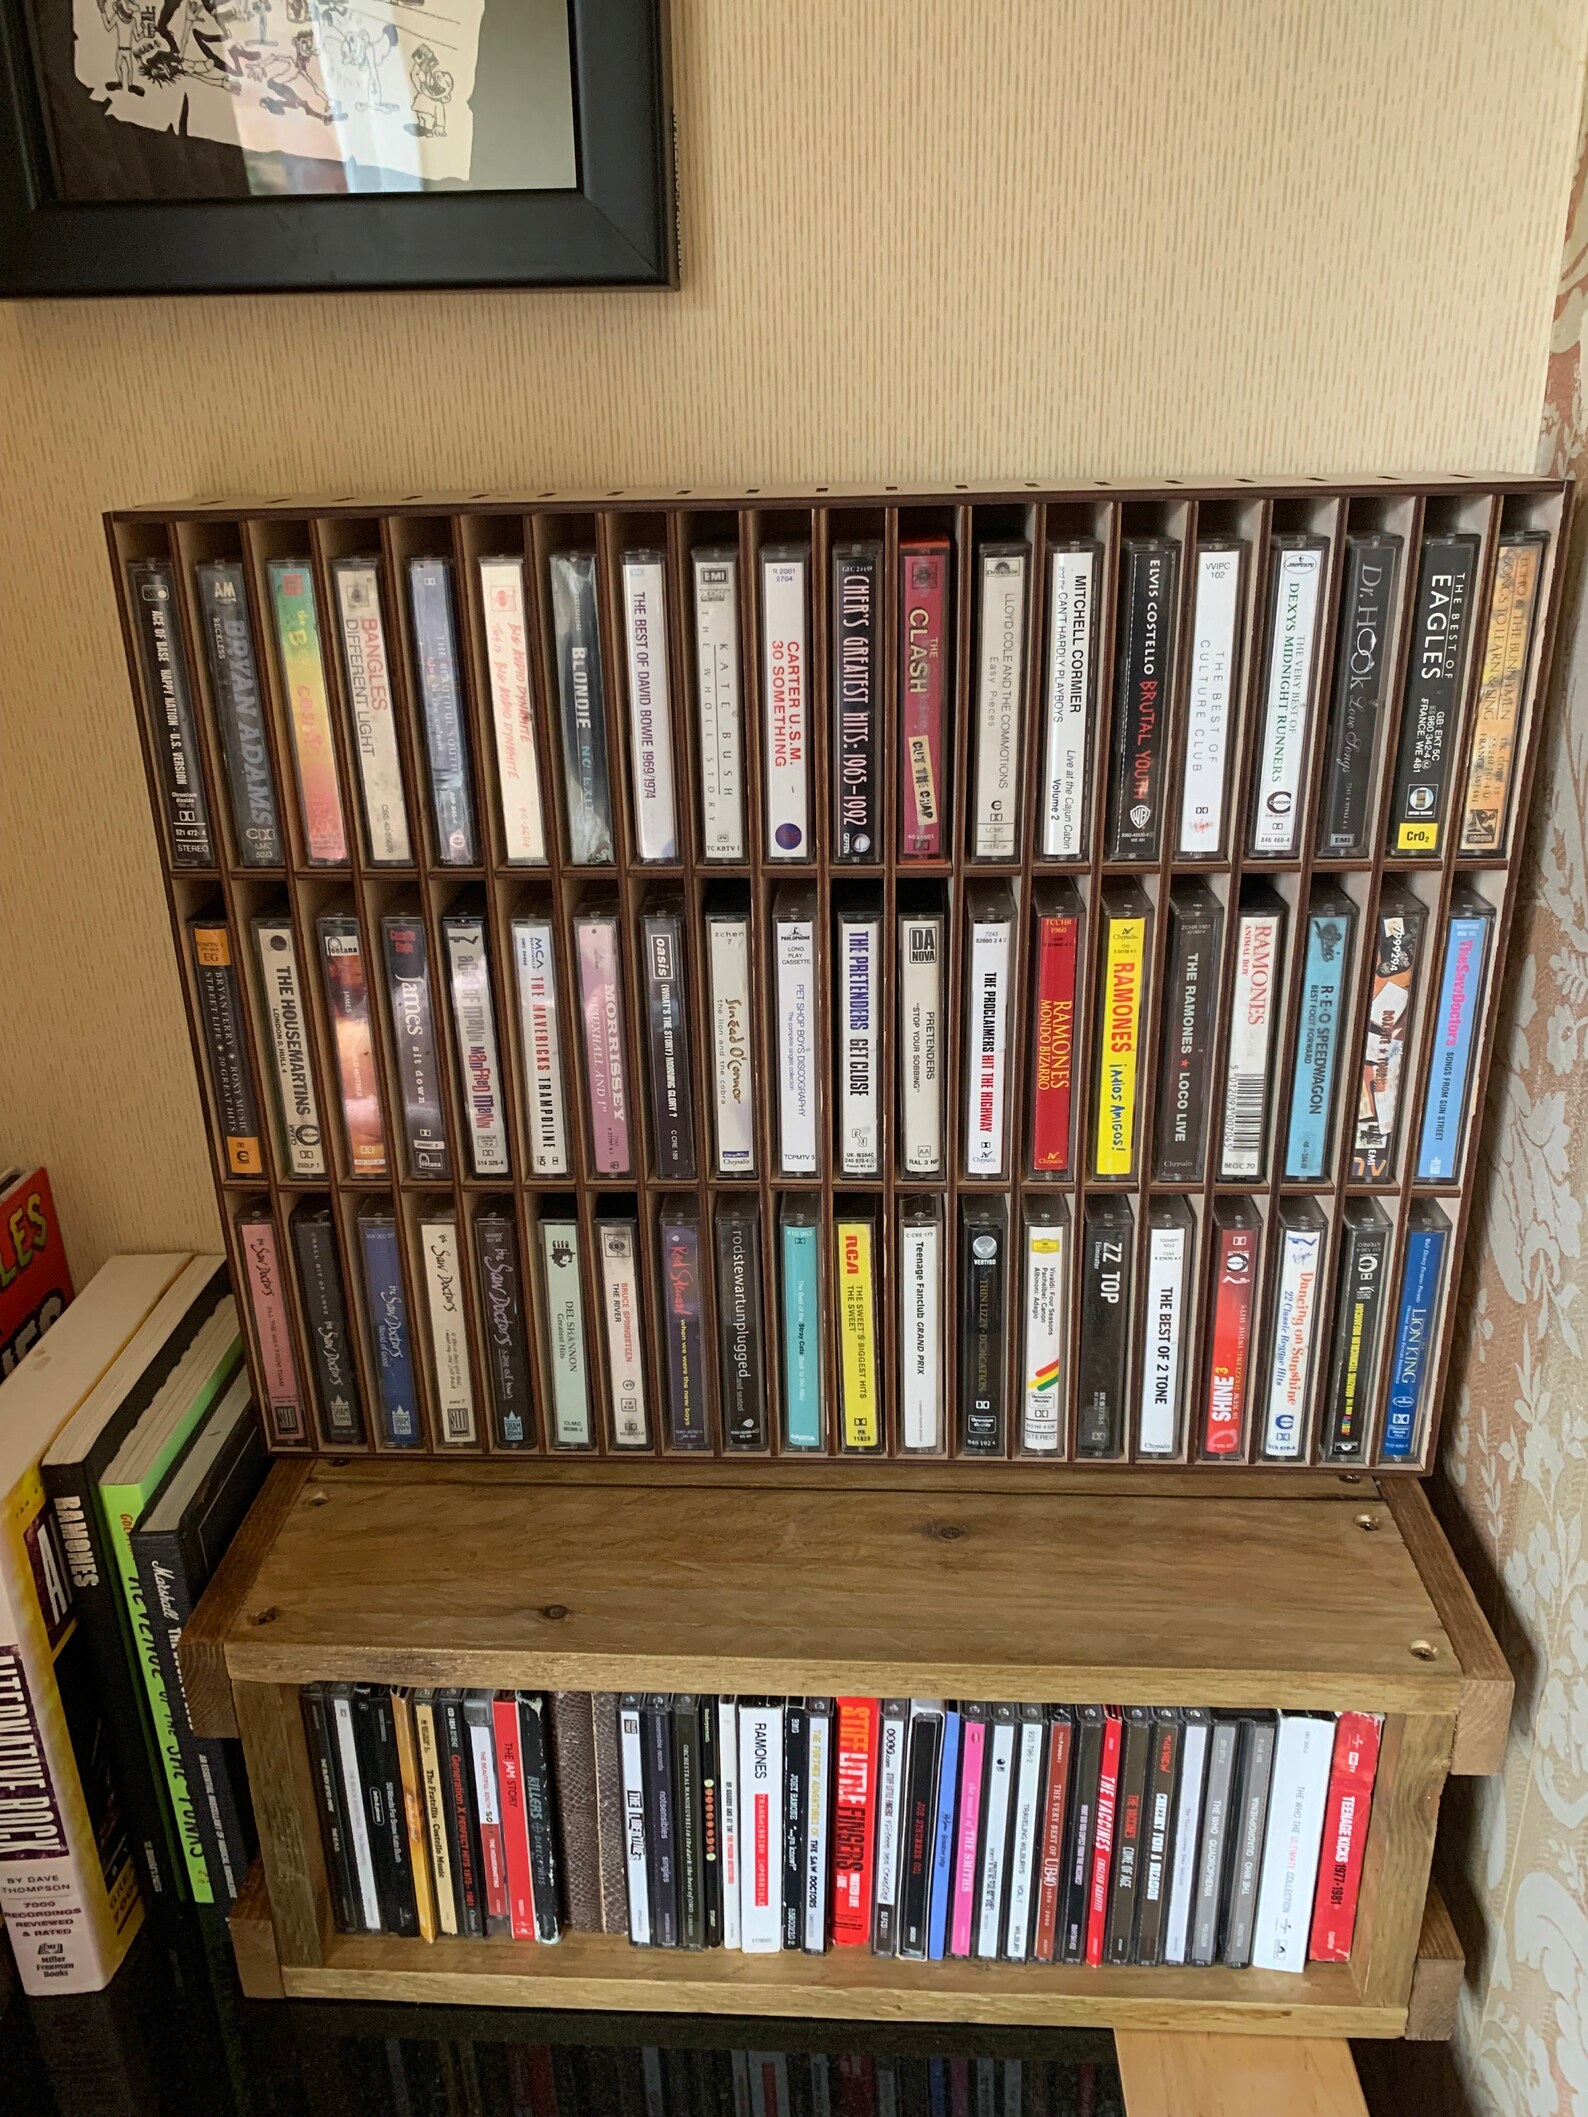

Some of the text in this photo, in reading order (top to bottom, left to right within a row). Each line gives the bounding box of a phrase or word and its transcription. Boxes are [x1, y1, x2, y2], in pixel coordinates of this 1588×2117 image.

[213, 618, 225, 659] RECKLESS
[362, 618, 387, 711] BANGLES
[909, 608, 930, 693] CLASH
[929, 637, 938, 658] THE
[1070, 575, 1086, 713] MITCHELL CORMIER
[1420, 574, 1451, 680] EAGLES
[1445, 573, 1465, 679] THE BEST OF
[346, 619, 374, 756] DIFFERENT LIGHT
[634, 593, 655, 798] THE BEST OF DAVID BOWIE 1969/1974
[772, 641, 786, 767] 30 SOMETHING
[787, 641, 801, 766] CARTER U.S.M.
[998, 593, 1014, 789] LLOYD COLE AND THE COMMOTIONS
[1192, 640, 1210, 771] CULTURE CLUB
[1209, 652, 1224, 763] THE BEST OF
[1271, 582, 1299, 782] DEXYS MIDNIGHT RUNNERS
[1289, 635, 1305, 734] THE VERY BEST OF
[1051, 779, 1061, 811] Volume
[1063, 750, 1075, 849] Live at the Cajun Cabin
[656, 938, 669, 976] oasis
[912, 930, 934, 950] DA
[1241, 925, 1252, 976] ANIMAL BOY
[1248, 925, 1271, 1025] RAMONES
[276, 966, 311, 1116] THE HOUSEMARTINS
[395, 974, 426, 1104] James sit down
[604, 984, 624, 1122] MORRISSEY
[796, 984, 806, 1116] PET SHOP BOYS DISCOGRAPHY
[849, 932, 868, 1096] THE PRETENDERS GET CLOSE
[926, 1012, 935, 1080] PRETENDERS
[980, 972, 996, 1132] THE PROCLAIMERS HIT THE HIGHWAY
[1038, 999, 1052, 1090] MONDO BIZARRO
[1051, 1000, 1072, 1088] RAMONES
[1175, 953, 1198, 1142] THE RAMONES LOCO LIVE
[1304, 985, 1318, 1064] BEST FOOT FORWARD
[531, 977, 555, 1148] THE MAVERICKS TRAMPOLINE
[1436, 1052, 1454, 1141] SONGS FROM SUN STREET
[846, 1236, 859, 1274] RCA
[1101, 1242, 1122, 1304] ZZ TOP
[1160, 1287, 1173, 1309] THE
[557, 1313, 565, 1342] Greatest
[565, 1301, 577, 1372] DEL SHANNON
[621, 1283, 632, 1362] BRUCE SPRINGSTEEN
[682, 1342, 687, 1354] we
[848, 1304, 856, 1332] SWEET
[915, 1242, 925, 1374] Teenage Fanclub GRAND PRIX
[1157, 1346, 1169, 1360] OF
[1158, 1313, 1171, 1342] BEST
[1287, 1272, 1313, 1405] Dancing on Sunshine
[1155, 1375, 1168, 1404] TONE
[54, 1496, 99, 1587] RAMONES
[150, 1561, 180, 1620] Marshall
[503, 1743, 518, 1807] THE JAM STORY
[755, 1723, 767, 1778] RAMONES
[836, 1706, 870, 1872] STIFF LITTLE FINGERS
[426, 1770, 446, 1878] The Fratellis Costello Music
[659, 1791, 670, 1882] notsensibles singles
[1093, 1775, 1114, 1912] THE VACCINES ENGLISH GRAFFITI
[1204, 1800, 1221, 1896] THE WHO QUADROPHENIA
[1241, 1797, 1259, 1895] THE WHO QUADROPHENIA
[1331, 1796, 1355, 1905] TEENAGE KICKS 1977-1981
[3, 1883, 70, 1894] THOMPSON
[3, 1907, 82, 1919] RECORDINGS
[7, 1874, 59, 1884] BY DAVE
[15, 1918, 74, 1928] REVIEWED
[23, 1900, 56, 1909] 7000
[35, 1928, 72, 1937] RATED
[36, 1962, 75, 1971] Freeman
[41, 1955, 66, 1964] Miller
[43, 1969, 69, 1978] Books
